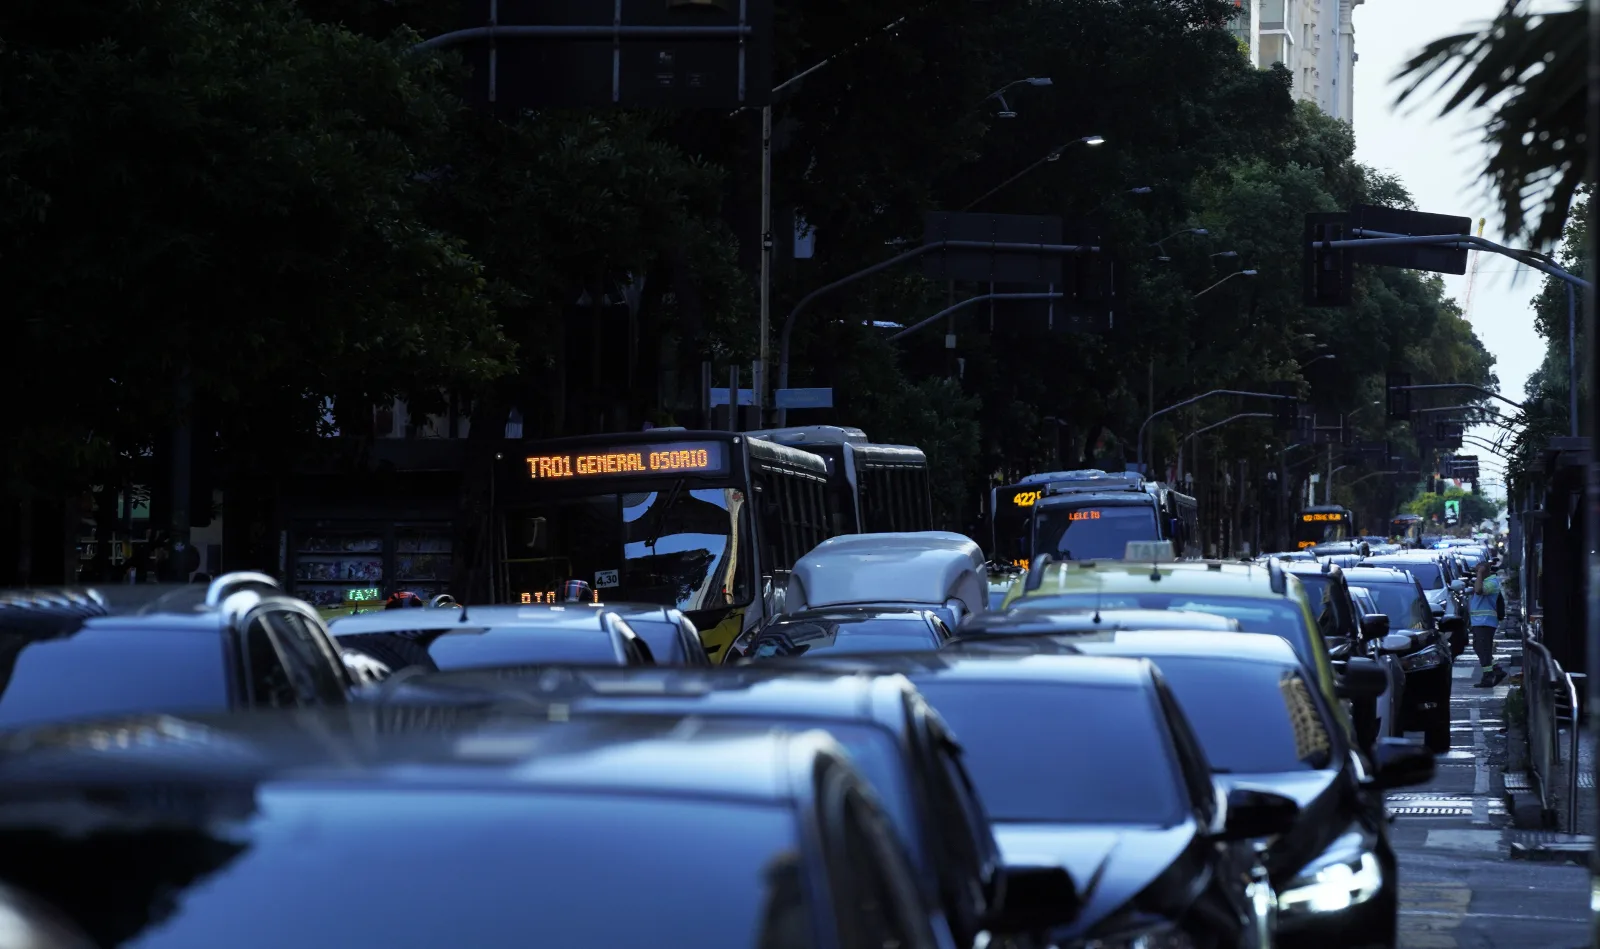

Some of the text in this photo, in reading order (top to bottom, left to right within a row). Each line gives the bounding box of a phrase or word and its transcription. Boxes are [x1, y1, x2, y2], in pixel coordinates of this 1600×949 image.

[577, 453, 647, 475] GENERAL
[649, 450, 707, 471] OSORIO
[596, 574, 617, 586] 4,30
[348, 588, 377, 601] TAXI
